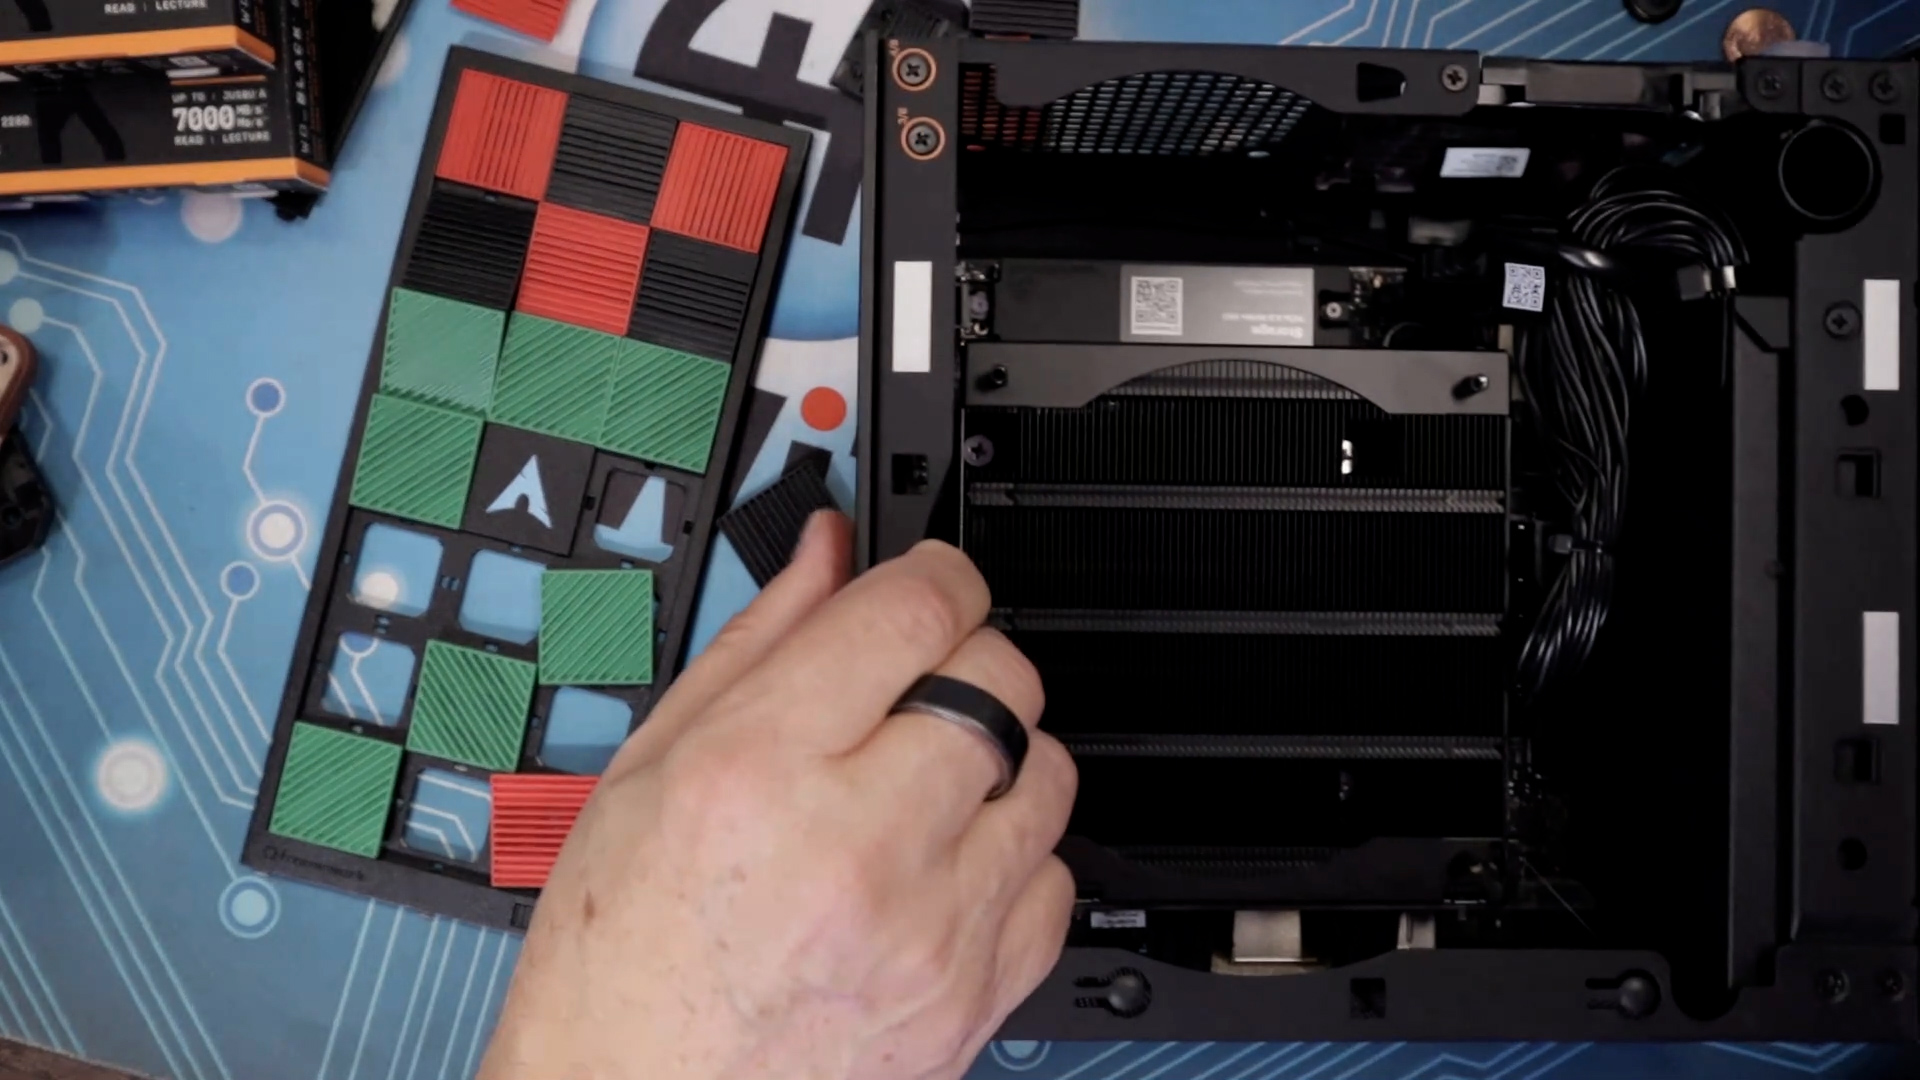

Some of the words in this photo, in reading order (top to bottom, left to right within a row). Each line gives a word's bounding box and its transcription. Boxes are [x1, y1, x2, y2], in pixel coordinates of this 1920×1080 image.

[104, 2, 136, 14] READ
[155, 0, 208, 10] LECTURE
[172, 104, 236, 132] 7000
[174, 134, 204, 146] READ
[222, 131, 270, 144] LECTURE
